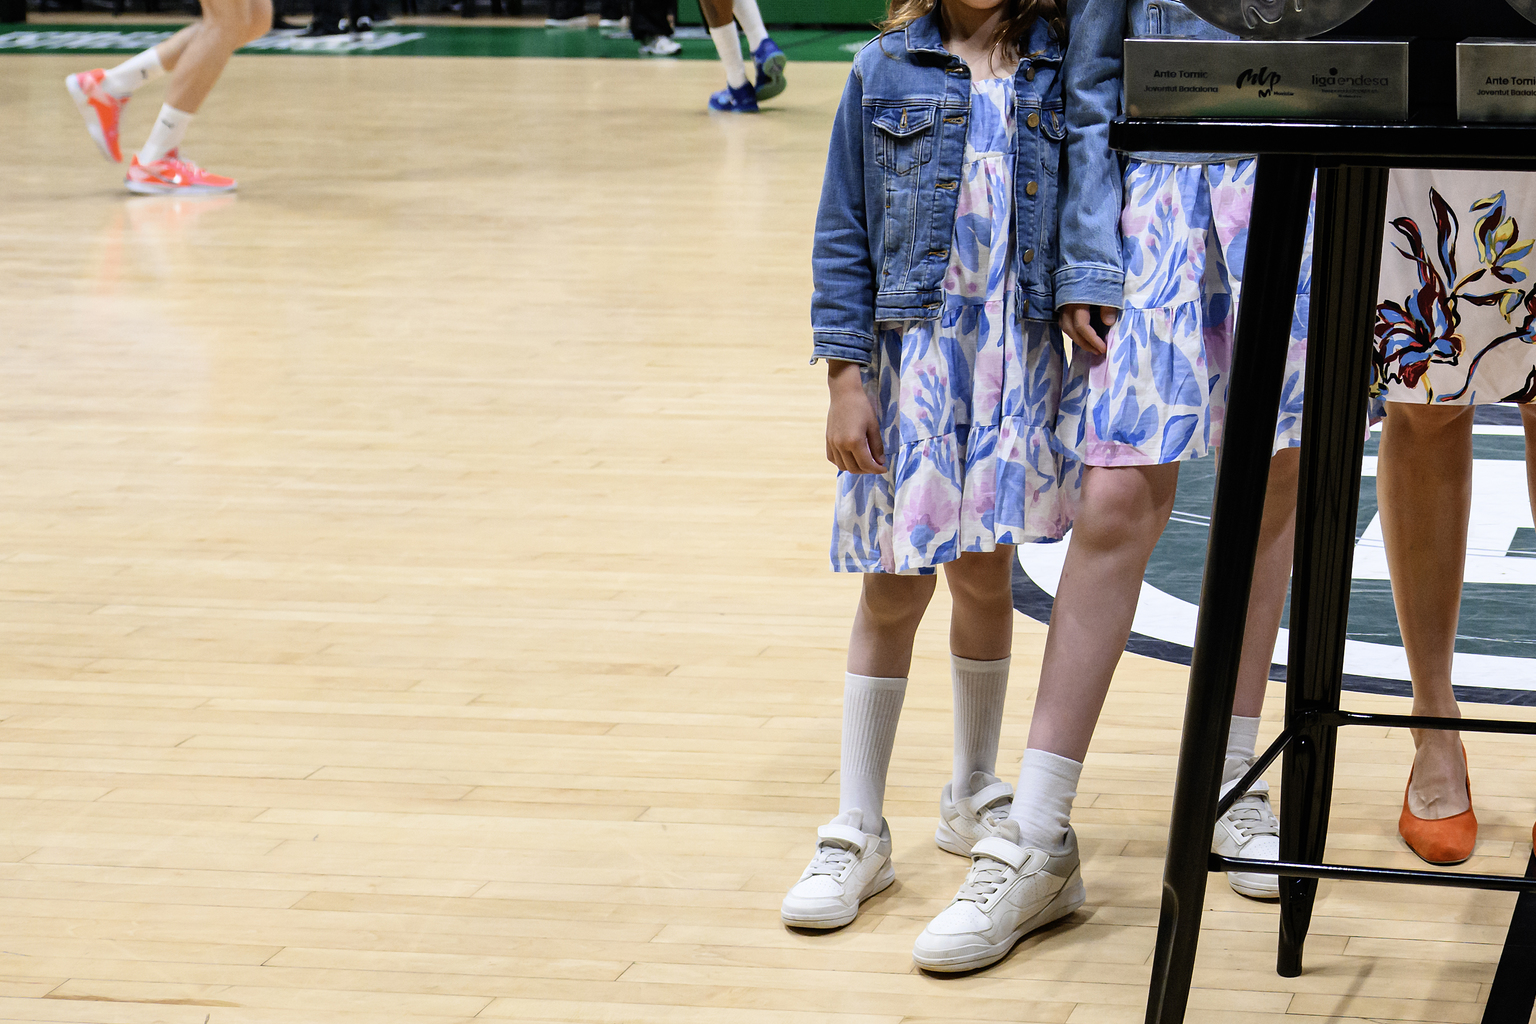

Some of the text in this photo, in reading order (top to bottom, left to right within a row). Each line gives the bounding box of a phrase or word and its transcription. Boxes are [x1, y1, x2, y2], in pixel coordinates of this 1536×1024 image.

[1153, 70, 1208, 78] Ante Tomic
[1311, 74, 1388, 87] liga endesa
[1485, 76, 1509, 85] Ante
